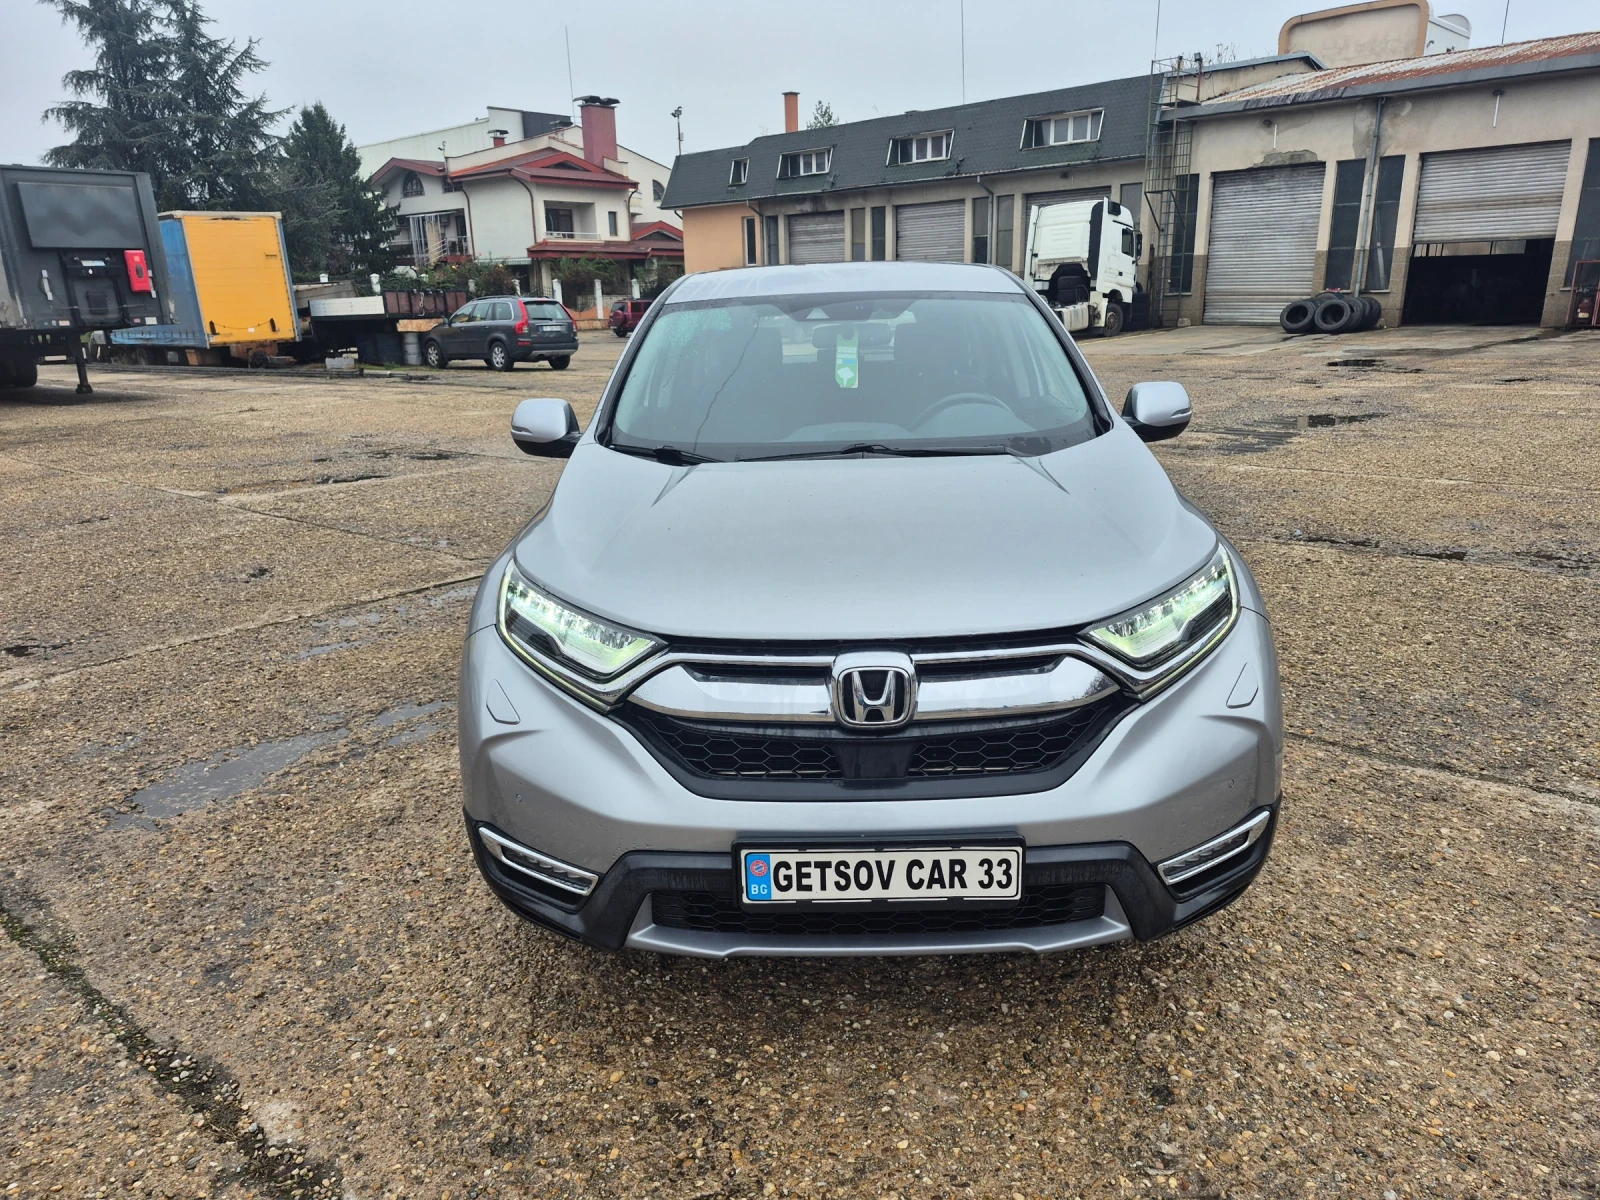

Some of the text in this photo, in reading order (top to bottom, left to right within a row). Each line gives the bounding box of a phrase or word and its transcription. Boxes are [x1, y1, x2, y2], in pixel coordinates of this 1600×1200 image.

[772, 859, 896, 893] GETSOV
[905, 858, 968, 891] CAR
[977, 857, 1013, 890] 33
[751, 883, 768, 895] BG
